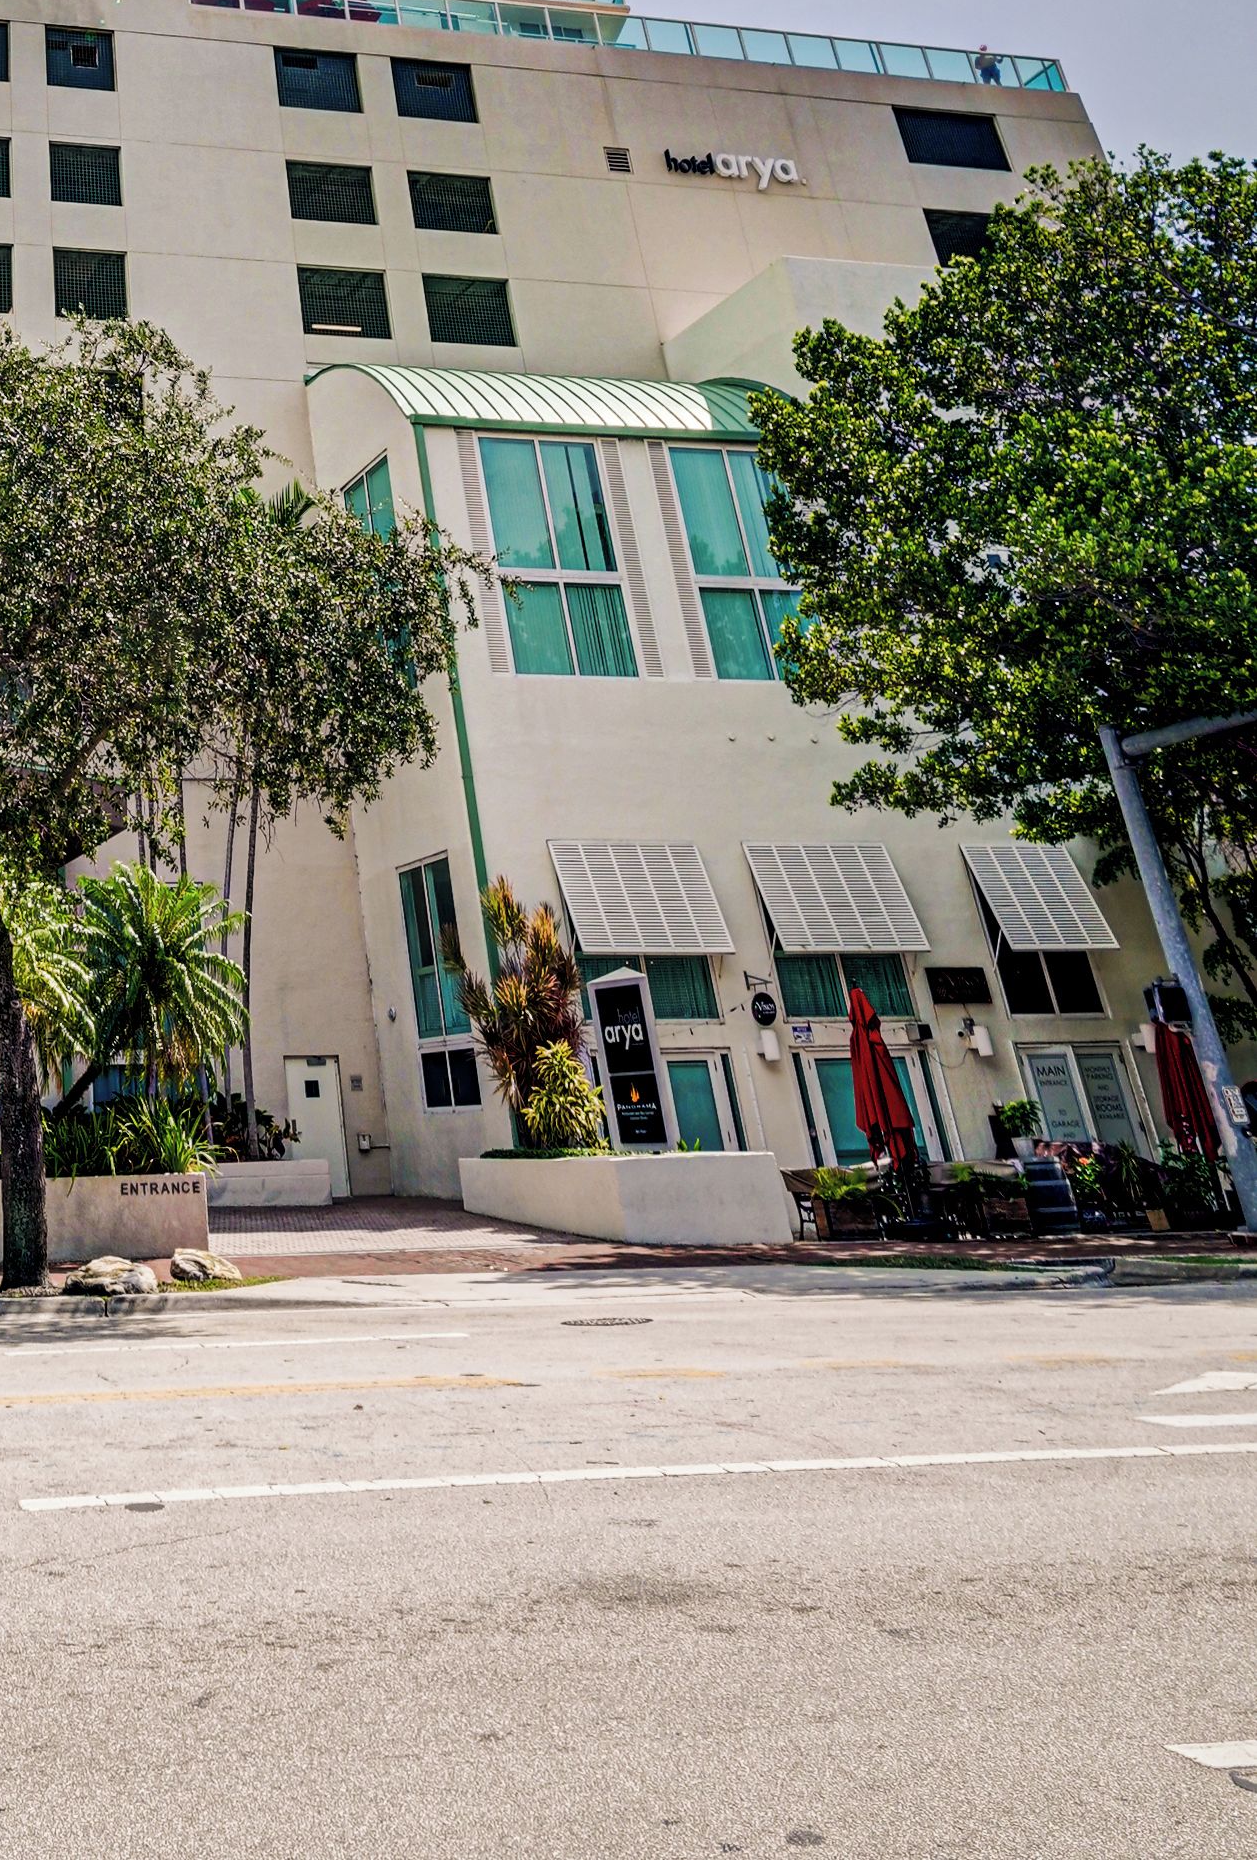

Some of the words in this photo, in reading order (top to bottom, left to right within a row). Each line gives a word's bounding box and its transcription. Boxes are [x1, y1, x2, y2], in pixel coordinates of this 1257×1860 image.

[663, 148, 715, 175] hotel
[616, 1006, 641, 1024] hotel
[604, 1023, 644, 1050] arya
[1036, 1066, 1066, 1077] MAIN
[1086, 1073, 1114, 1081] PARKING
[1096, 1103, 1123, 1112] ROOMS
[1051, 1120, 1081, 1128] GARAGE
[120, 1181, 201, 1196] ENTRANCE
